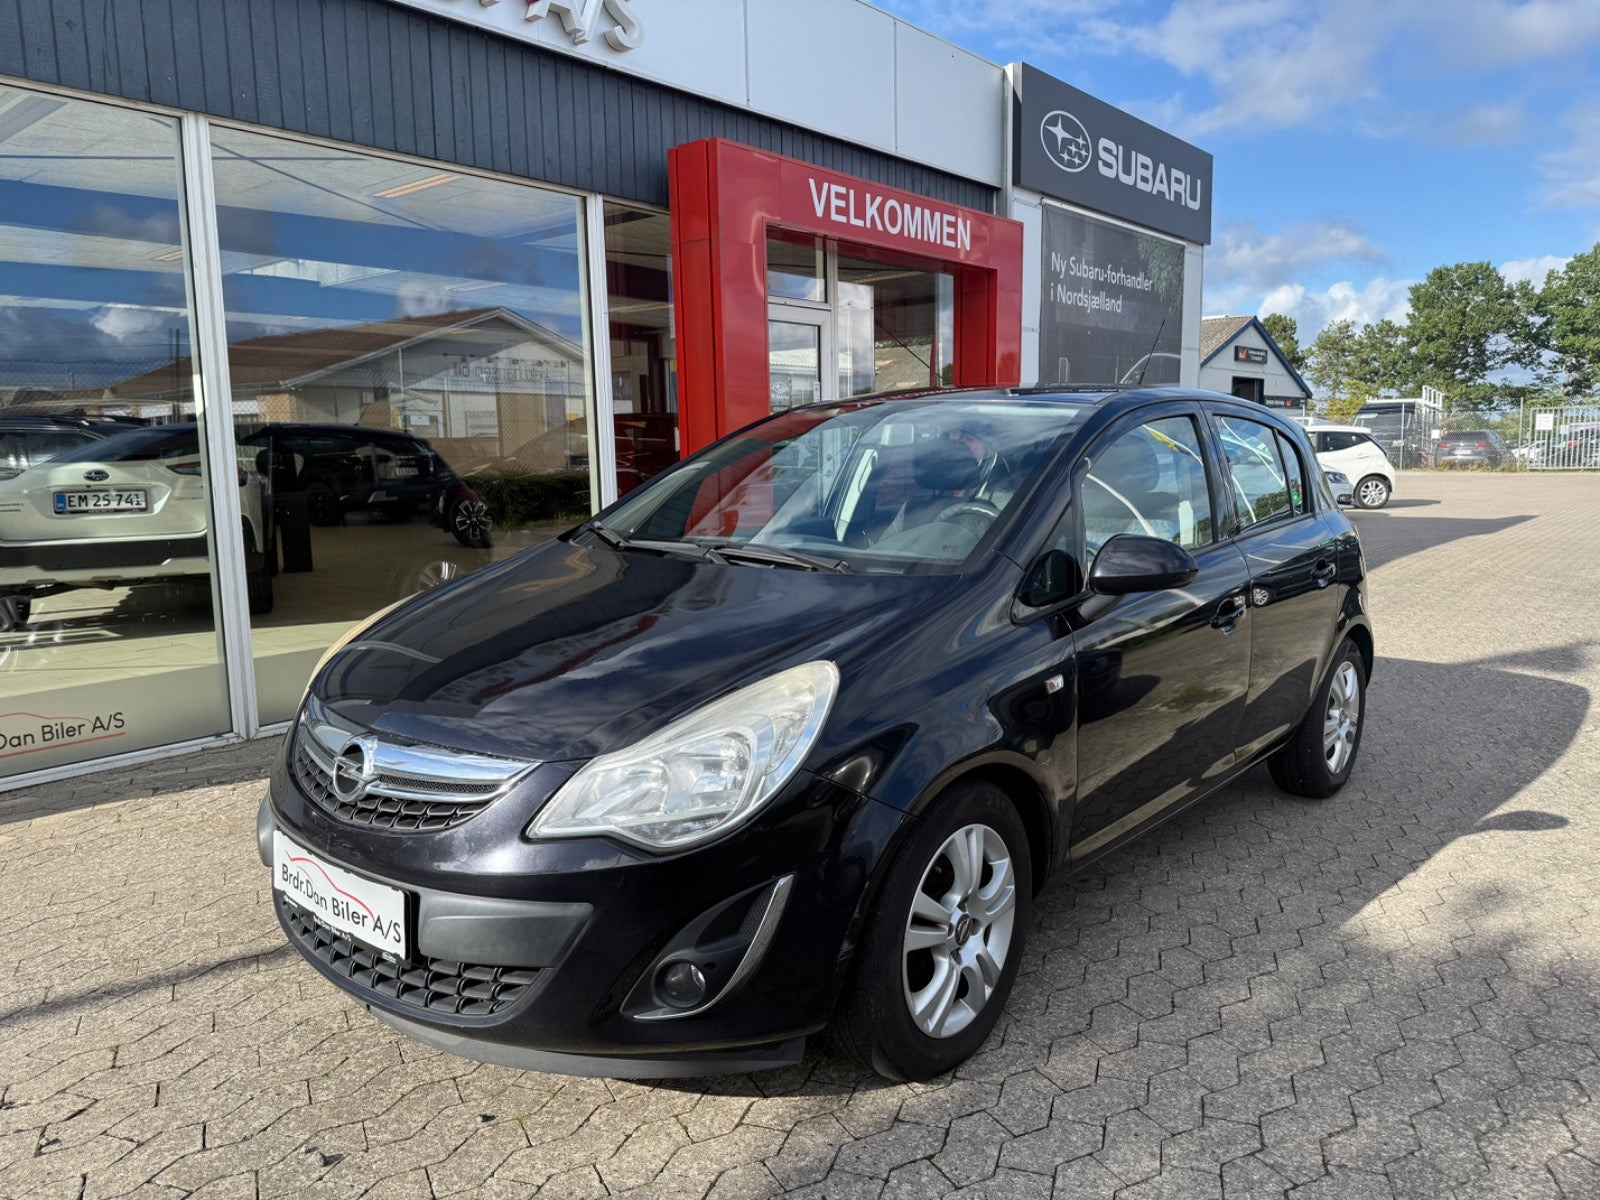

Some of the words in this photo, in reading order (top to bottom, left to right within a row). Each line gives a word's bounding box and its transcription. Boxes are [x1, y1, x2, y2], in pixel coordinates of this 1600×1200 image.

[1098, 137, 1201, 211] SUBARU
[808, 178, 971, 251] VELKOMMEN
[1051, 251, 1067, 278] Ny
[1069, 256, 1153, 292] Subaru-forhandler
[1050, 282, 1054, 302] i
[1057, 283, 1123, 314] Nordsjælland
[67, 495, 89, 507] EM
[93, 494, 111, 507] 25
[116, 494, 142, 506] 741
[41, 722, 86, 742] Biler
[91, 712, 125, 733] A/S
[281, 863, 328, 911] Brdr.Dan
[332, 897, 369, 928] Biler
[372, 915, 402, 943] A/S
